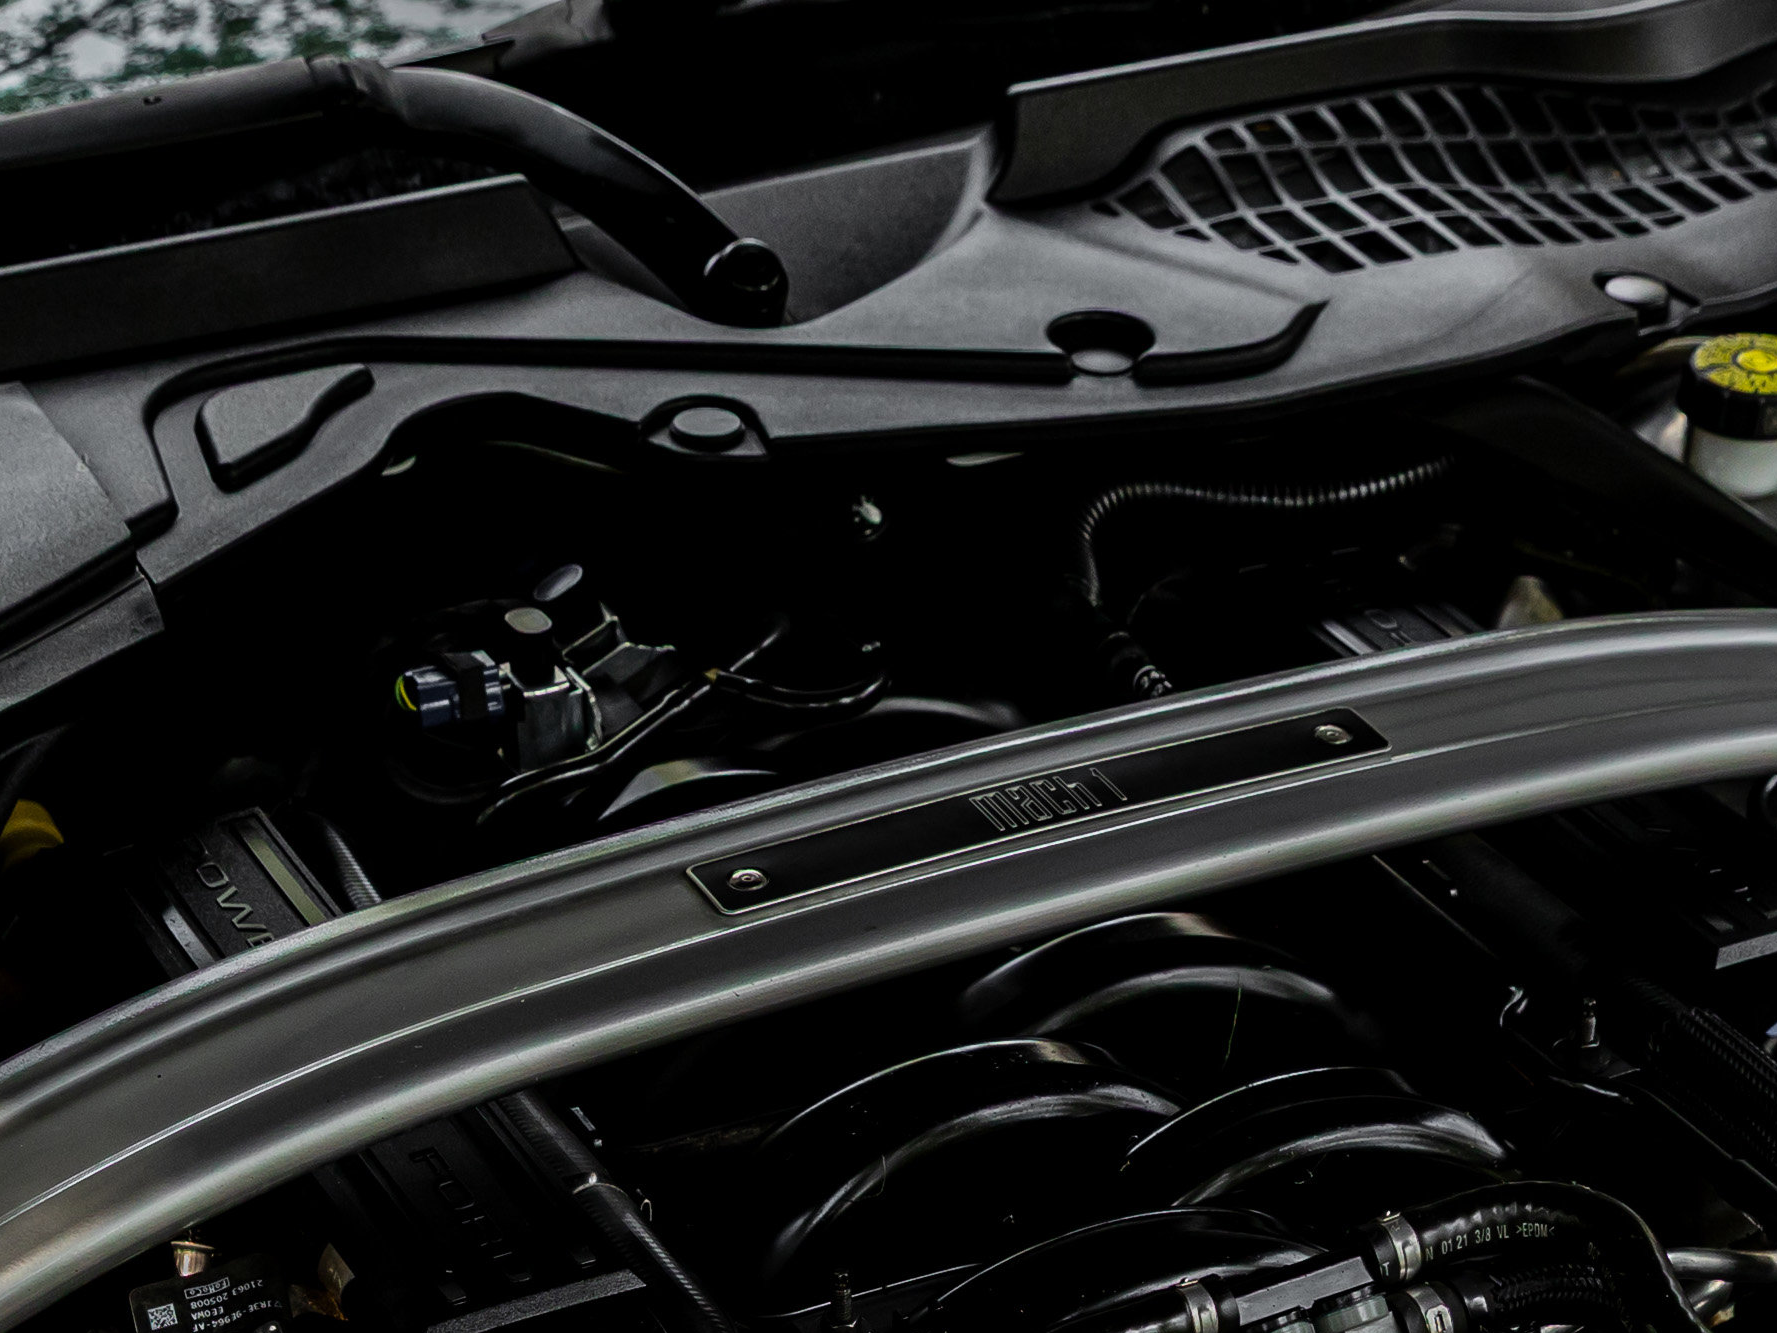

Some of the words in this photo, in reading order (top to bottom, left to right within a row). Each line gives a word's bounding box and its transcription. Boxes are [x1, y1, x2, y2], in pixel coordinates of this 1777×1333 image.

[968, 776, 1103, 832] mach
[1089, 766, 1128, 802] 1
[1474, 1227, 1492, 1244] 3/8
[1496, 1224, 1510, 1240] VL
[187, 1278, 229, 1296] FoMoCo
[230, 1278, 263, 1295] 21063
[189, 1291, 229, 1309] 205008
